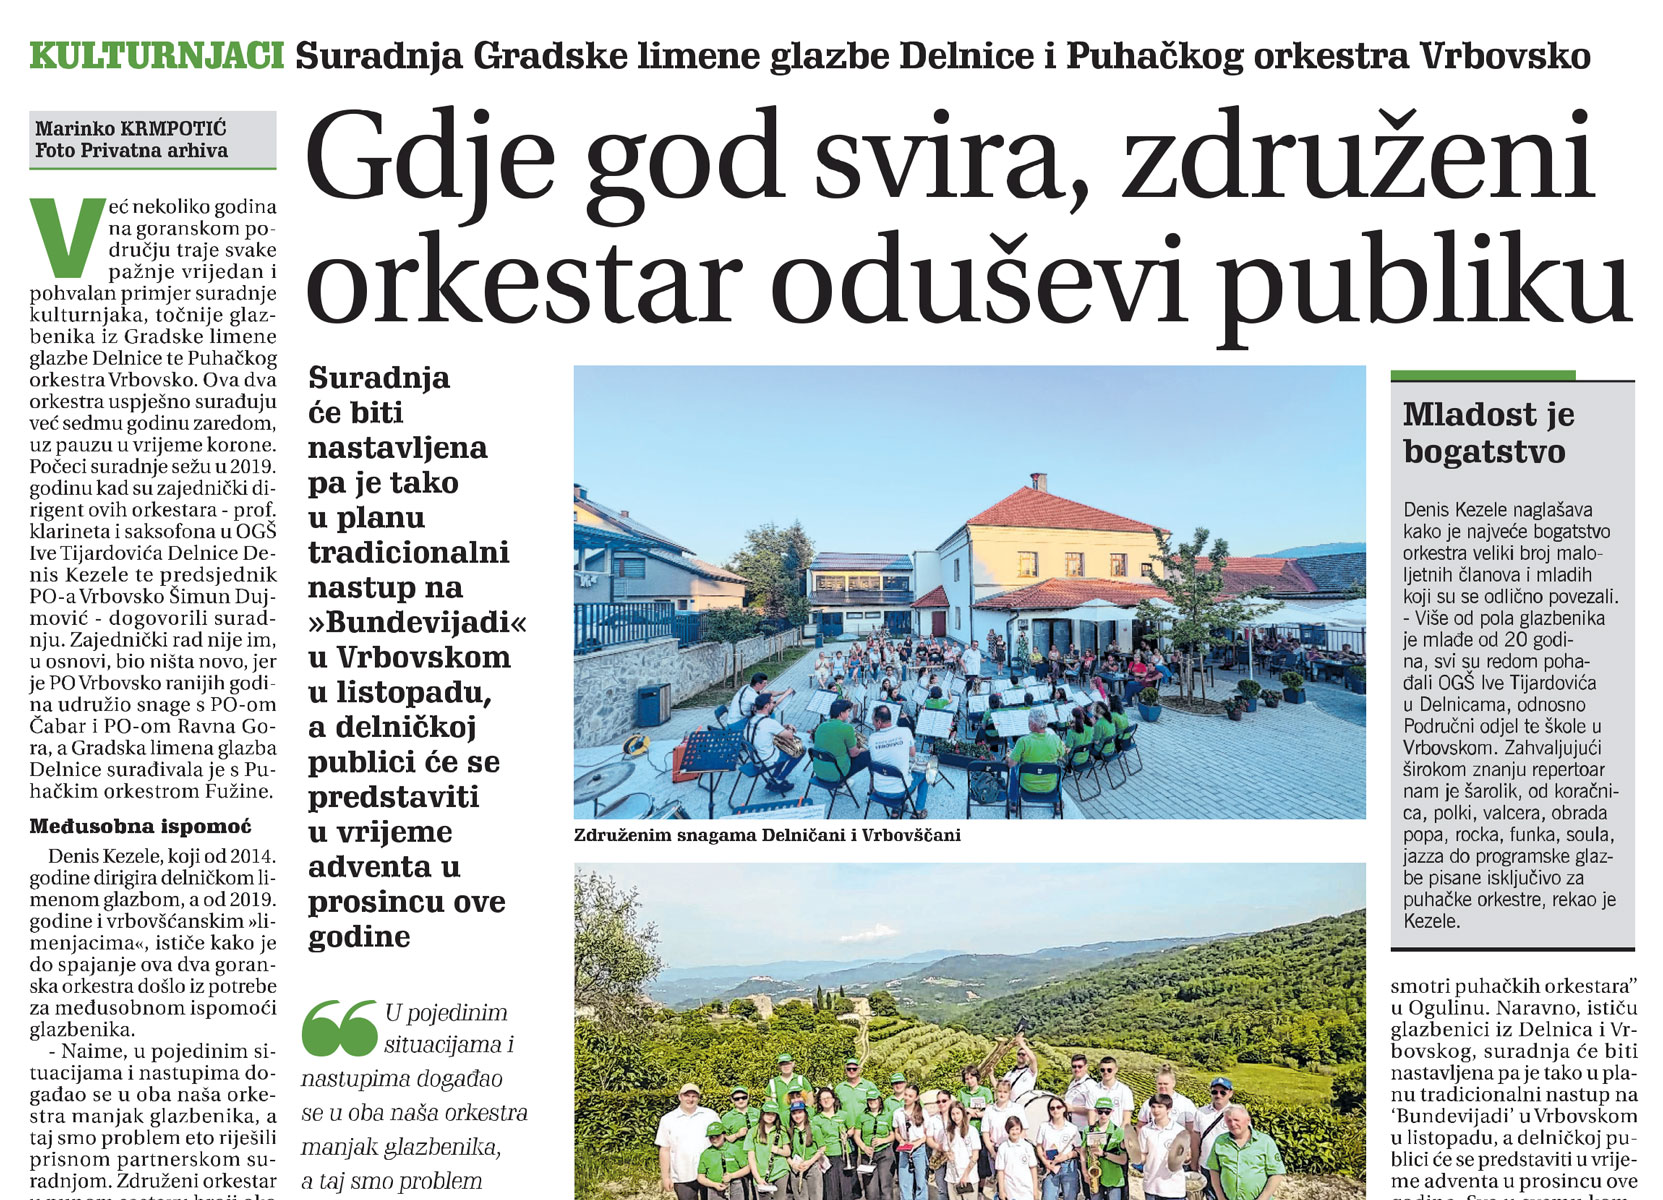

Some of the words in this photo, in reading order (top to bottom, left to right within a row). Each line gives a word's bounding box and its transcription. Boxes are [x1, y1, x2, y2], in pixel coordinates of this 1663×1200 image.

[30, 41, 284, 69] KULTURNJACI
[297, 41, 463, 76] Suradnja
[474, 41, 627, 69] Gradske
[638, 41, 760, 69] limene
[770, 41, 889, 76] glazbe
[900, 41, 1034, 69] Delnice
[1045, 41, 1056, 68] i
[1067, 41, 1244, 76] Puhačkog
[1255, 41, 1410, 69] orkestra
[1419, 41, 1591, 69] Vrbovsko
[36, 121, 115, 136] Marinko
[121, 117, 226, 136] KRMPOTIĆ
[36, 142, 75, 157] Foto
[81, 143, 162, 157] Privatna
[168, 142, 228, 157] arhiva
[307, 105, 554, 228] Gdje
[587, 105, 786, 227] god
[816, 109, 1088, 215] svira,
[1122, 105, 1596, 199] združeni
[307, 229, 743, 324] orkestar
[772, 229, 1189, 324] oduševi
[1216, 229, 1633, 350] publiku
[30, 350, 87, 370] glazbe
[93, 350, 162, 365] Delnice
[167, 352, 183, 365] te
[188, 350, 277, 370] Puhačkog
[310, 365, 450, 394] Suradnja
[309, 400, 340, 423] će
[350, 401, 403, 423] biti
[1404, 402, 1537, 426] Mladost
[1547, 401, 1574, 432] je
[308, 435, 488, 464] nastavljena
[1403, 439, 1565, 469] bogatstvo
[308, 476, 346, 499] pa
[356, 471, 381, 499] je
[390, 471, 458, 494] tako
[308, 512, 327, 528] u
[337, 505, 425, 533] planu
[1405, 502, 1449, 517] Denis
[1456, 502, 1507, 517] Kezele
[1514, 501, 1592, 520] naglašava
[1404, 523, 1441, 538] kako
[1446, 523, 1460, 542] je
[1468, 523, 1527, 542] najveće
[1535, 523, 1610, 542] bogatstvo
[308, 540, 510, 564] tradicionalni
[308, 577, 416, 603] nastup
[425, 581, 463, 598] na
[309, 610, 526, 639] »Bundevijadi«
[308, 651, 327, 668] u
[336, 646, 511, 668] Vrbovskom
[308, 686, 327, 703] u
[337, 680, 491, 709] listopadu,
[309, 721, 326, 738] a
[336, 714, 475, 743] delničkoj
[308, 750, 416, 778] publici
[425, 750, 458, 773] će
[468, 756, 499, 773] se
[308, 784, 479, 813] predstaviti
[30, 818, 155, 834] Međusobna
[161, 818, 251, 838] ispomoć
[308, 826, 327, 843] u
[336, 820, 452, 848] vrijeme
[574, 828, 672, 841] Združenim
[678, 831, 757, 845] snagama
[762, 828, 846, 842] Delničani
[851, 829, 857, 841] i
[862, 828, 961, 842] Vrbovščani
[309, 855, 432, 877] adventa
[441, 861, 460, 877] u
[308, 889, 445, 918] prosincu
[454, 895, 505, 913] ove
[1405, 913, 1460, 928] Kezele.
[308, 925, 410, 953] godine
[387, 1003, 403, 1021] U
[406, 1003, 507, 1026] pojedinim
[1392, 1004, 1402, 1015] u
[1409, 999, 1489, 1019] Ogulinu.
[1496, 1001, 1580, 1017] Naravno,
[1588, 1000, 1637, 1015] ističu
[384, 1035, 501, 1057] situacijama
[507, 1035, 514, 1052] i
[300, 1069, 410, 1091] nastupima
[417, 1069, 502, 1092] događao
[302, 1108, 323, 1121] se
[330, 1108, 342, 1121] u
[349, 1103, 384, 1121] oba
[390, 1103, 438, 1121] naša
[446, 1103, 528, 1121] orkestra
[300, 1137, 379, 1160] manjak
[384, 1137, 500, 1160] glazbenika,
[302, 1176, 312, 1189] a
[320, 1172, 345, 1194] taj
[351, 1176, 393, 1189] smo
[397, 1171, 482, 1194] problem
